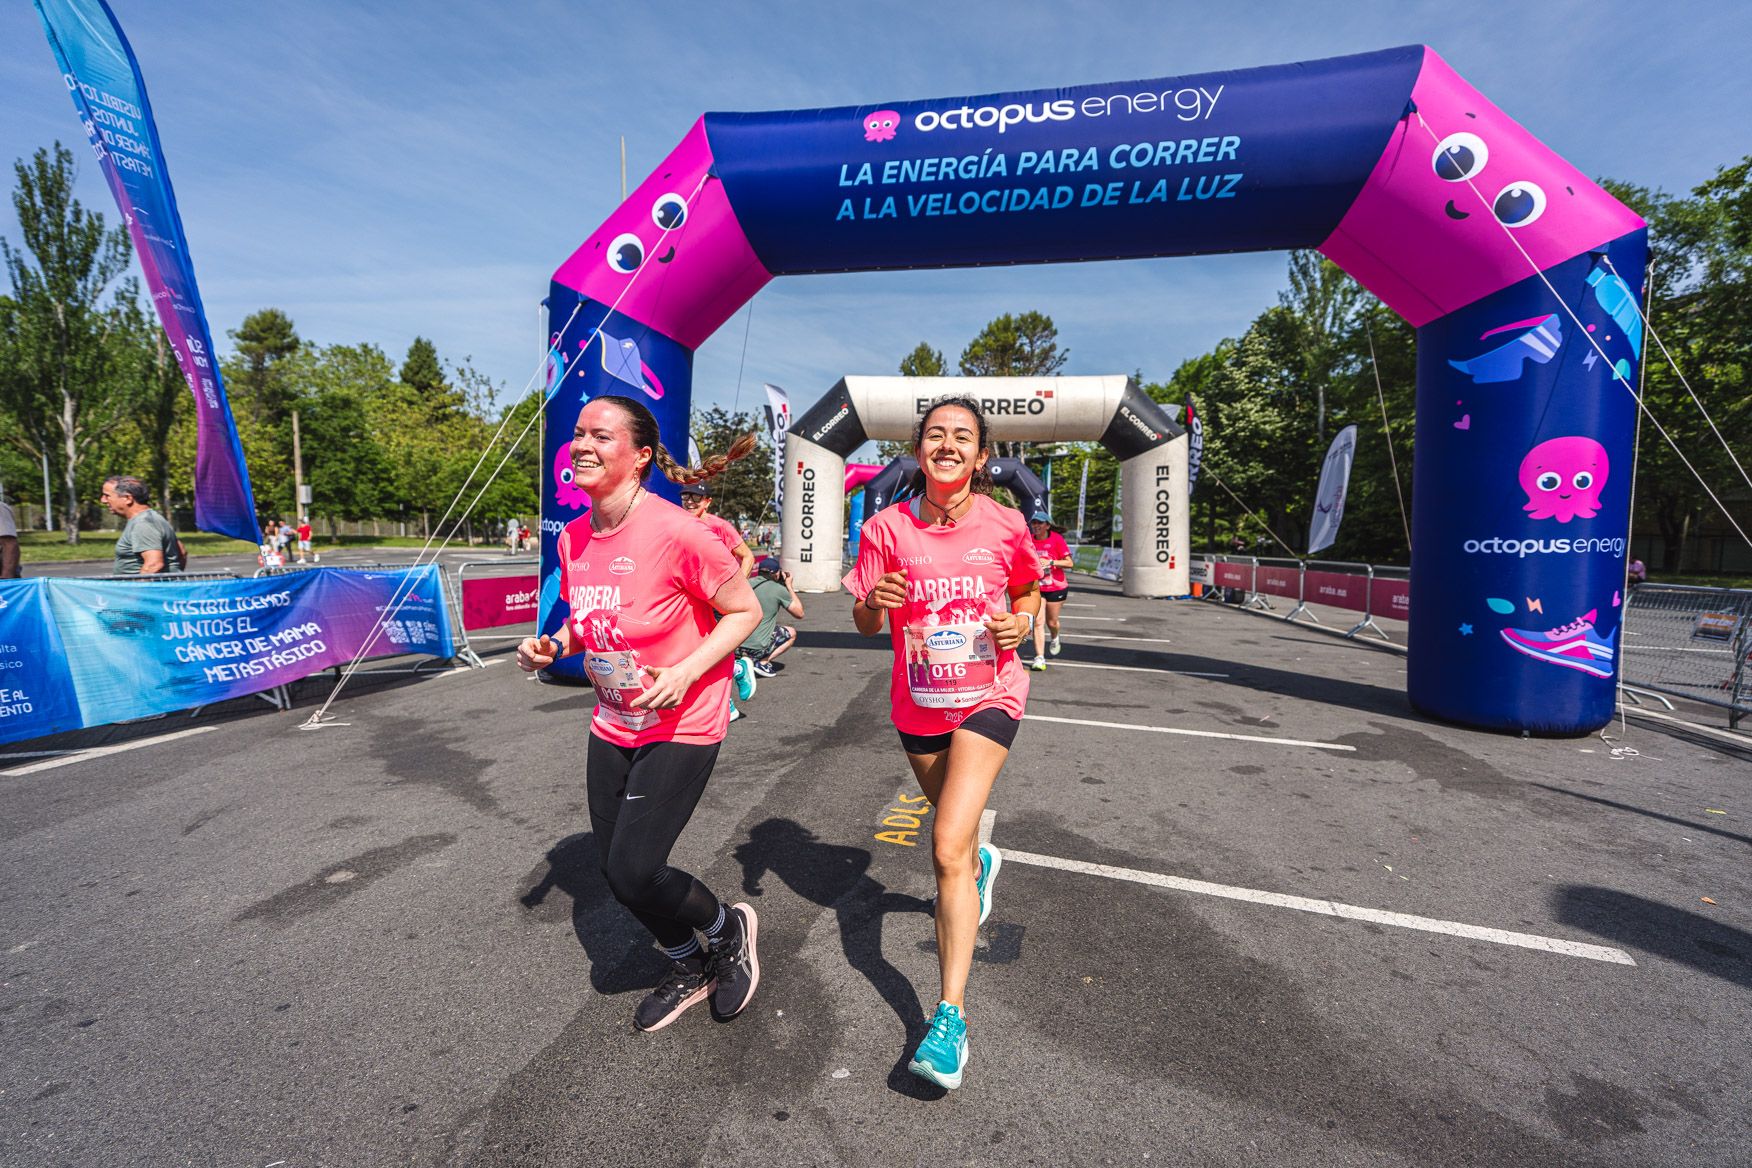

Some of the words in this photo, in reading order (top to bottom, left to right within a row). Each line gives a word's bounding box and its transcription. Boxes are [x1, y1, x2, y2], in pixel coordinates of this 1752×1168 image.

[914, 99, 1076, 133] octopus
[1081, 85, 1224, 122] energy
[838, 163, 874, 187] LA
[881, 148, 1008, 184] ENERGÍA
[1016, 146, 1099, 176] PARA
[1108, 135, 1241, 169] CORRER
[836, 200, 855, 221] A
[863, 196, 897, 219] LA
[907, 183, 1074, 217] VELOCIDAD
[1080, 182, 1124, 208] DE
[1128, 178, 1169, 204] LA
[1176, 173, 1244, 200] LUZ
[973, 398, 1045, 415] RREO
[812, 432, 823, 442] EL
[820, 407, 849, 434] CORREO
[1120, 406, 1130, 418] EL
[1128, 414, 1157, 441] CORREO
[1156, 465, 1169, 487] EL
[801, 468, 815, 540] CORREO
[1156, 489, 1169, 563] CORREO
[800, 543, 813, 562] EL
[1463, 537, 1570, 558] octopus
[897, 555, 932, 567] OYSHO
[569, 585, 621, 610] CARRERA
[906, 575, 986, 602] CARRERA
[163, 591, 291, 615] VISIBILICEMOS
[161, 617, 233, 641] JUNTOS
[237, 616, 259, 633] EL
[0, 644, 17, 654] lta
[174, 640, 246, 663] CÁNCER
[244, 636, 272, 654] DE
[268, 622, 322, 647] MAMA
[929, 638, 964, 646] ASTURIANA
[0, 660, 23, 670] sico
[203, 639, 327, 683] METASTÁSICO
[932, 663, 967, 678] 016
[12, 689, 30, 702] AL
[0, 702, 33, 718] ENTO
